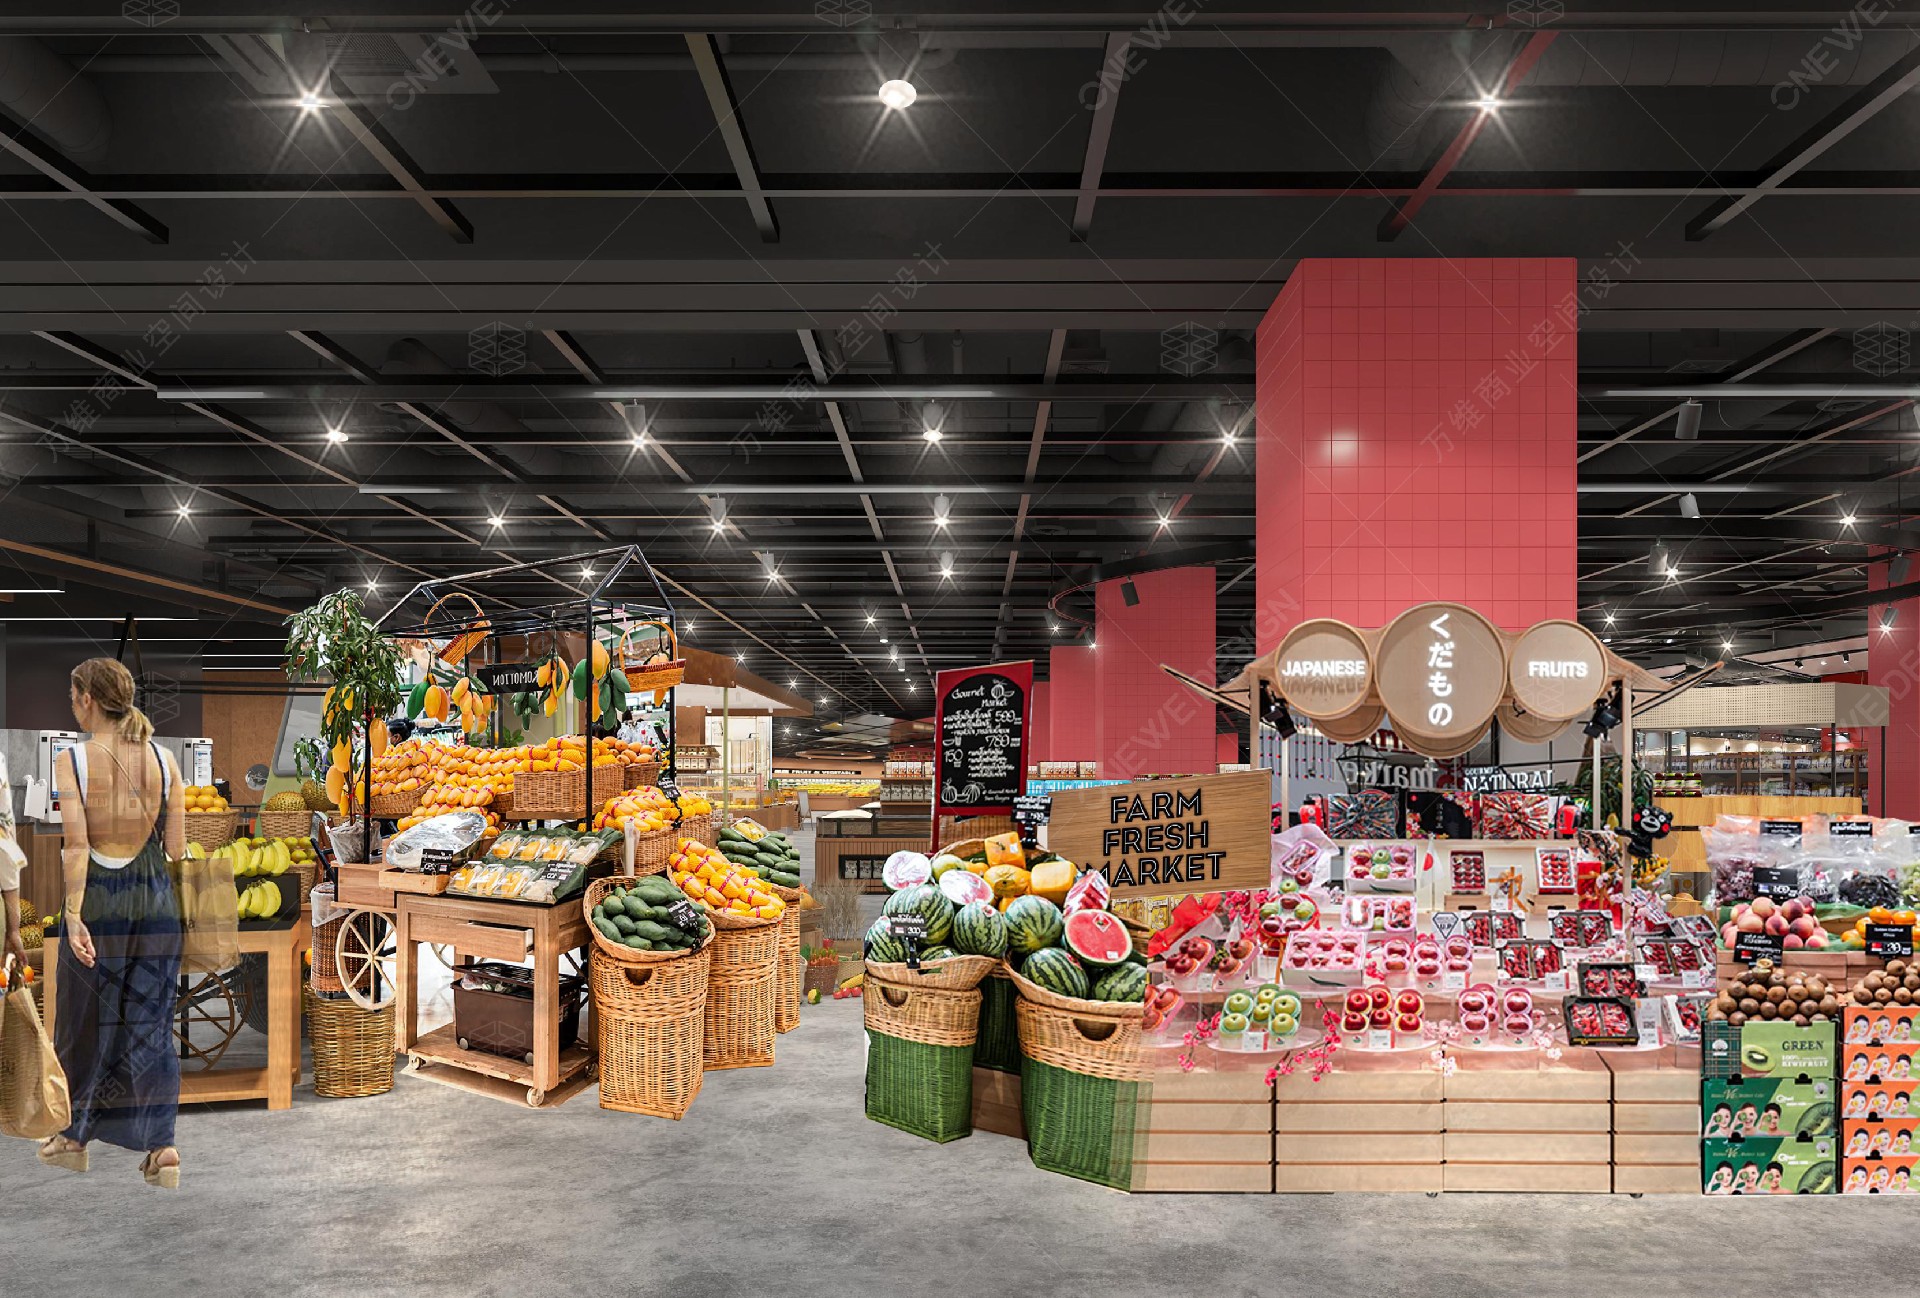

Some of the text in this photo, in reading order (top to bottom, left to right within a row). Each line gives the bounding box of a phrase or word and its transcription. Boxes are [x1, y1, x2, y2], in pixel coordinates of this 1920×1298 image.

[1281, 660, 1366, 677] JAPANESE
[1427, 612, 1456, 726] くだもの
[1528, 661, 1589, 678] FRUITS
[1110, 787, 1202, 824] FARM
[1102, 820, 1209, 856] FRESH
[1086, 851, 1226, 888] MARKET
[1781, 1040, 1825, 1052] GREEN
